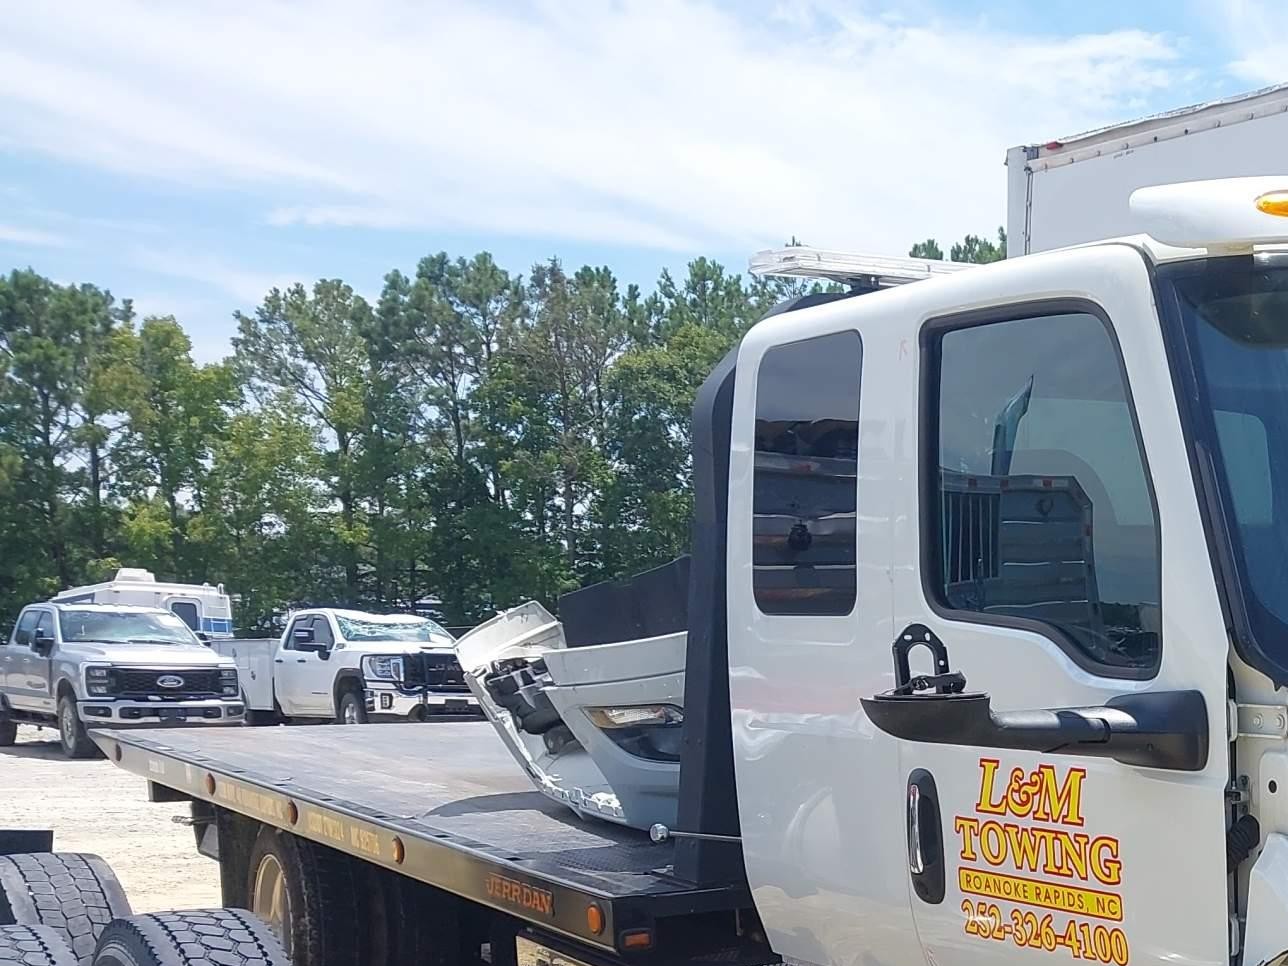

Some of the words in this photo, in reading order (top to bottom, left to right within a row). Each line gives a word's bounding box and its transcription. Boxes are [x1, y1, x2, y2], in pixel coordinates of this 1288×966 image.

[976, 758, 1086, 826] L&M
[955, 817, 1122, 885] TOWING
[965, 873, 1029, 900] ROANOKE
[1035, 882, 1089, 912] RAPIDS,
[1096, 898, 1118, 916] NC
[961, 899, 1129, 966] 252-326-4100
